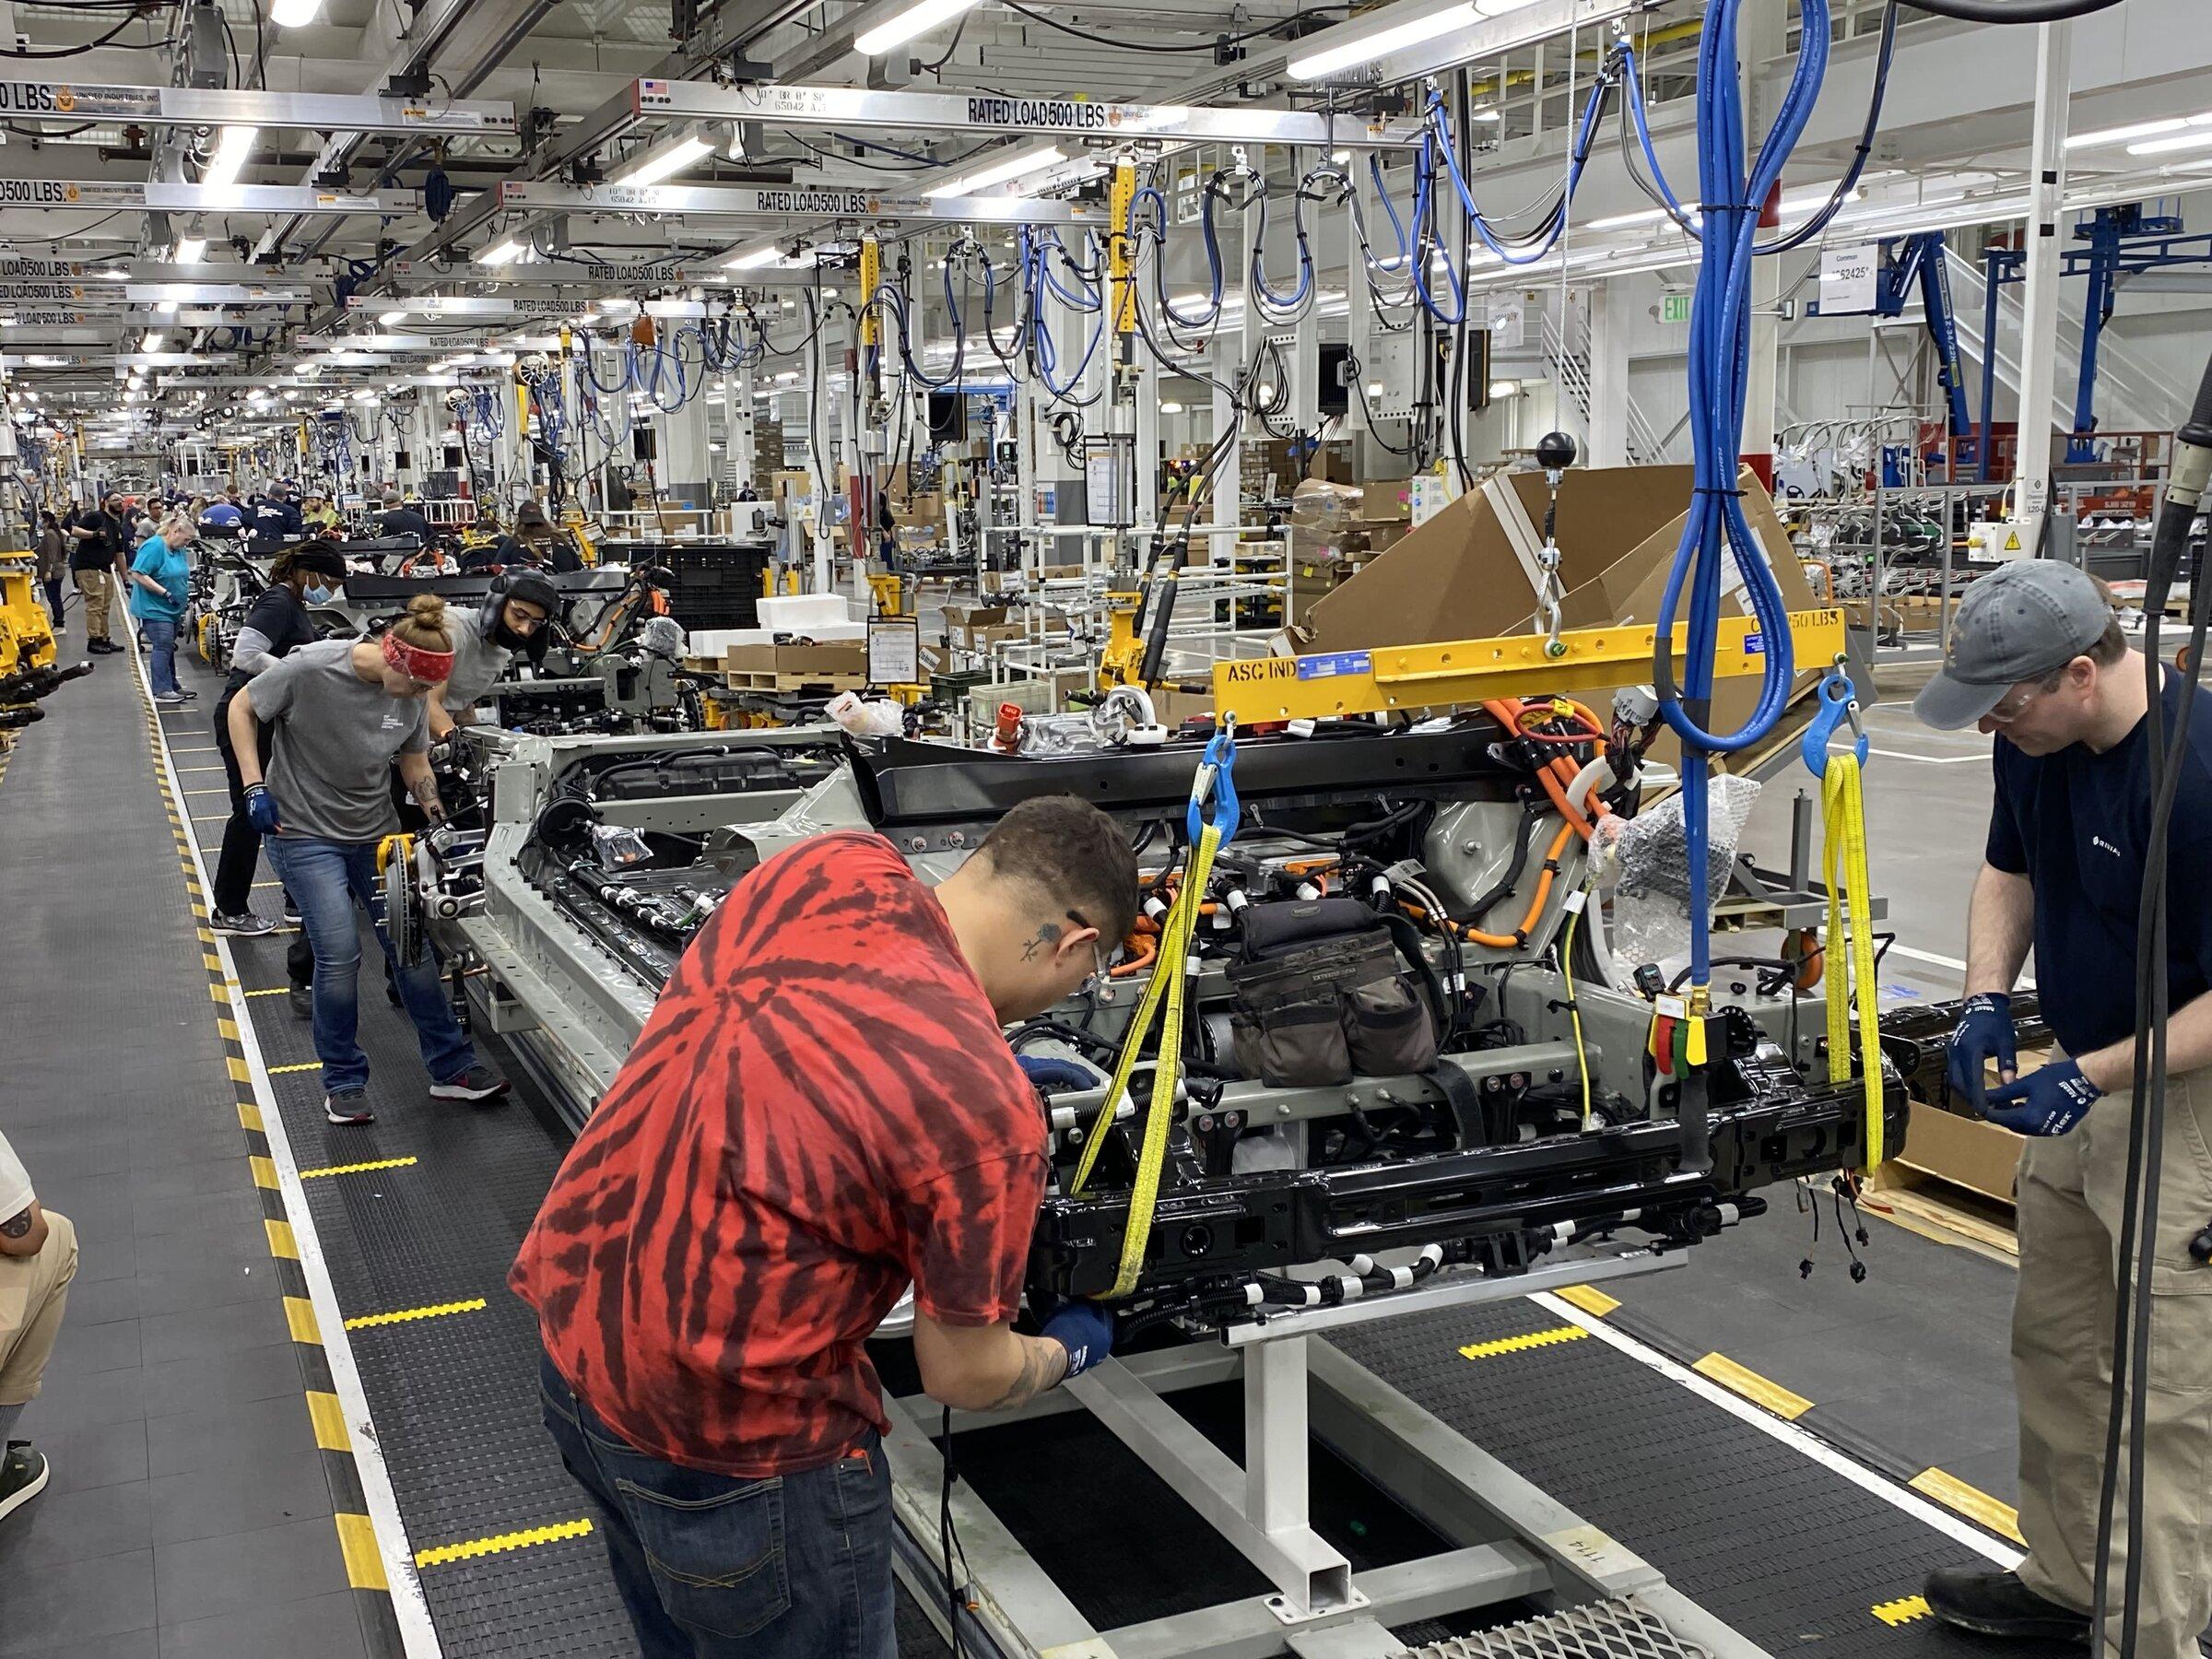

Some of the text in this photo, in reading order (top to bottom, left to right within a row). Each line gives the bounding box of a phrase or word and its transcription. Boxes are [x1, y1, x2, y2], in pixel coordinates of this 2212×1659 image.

[14, 83, 57, 112] LBS.
[968, 98, 1010, 124] RATED
[1014, 100, 1073, 127] LOAD500
[34, 181, 66, 202] LBS.
[758, 192, 869, 215] RATED LOAD500 LBS.
[2, 261, 45, 276] LOAD500
[589, 265, 614, 280] RATED
[617, 266, 653, 280] LOAD500
[12, 286, 50, 299] LOAD500
[513, 300, 535, 312] RATED
[537, 300, 569, 312] LOAD500
[1665, 296, 1690, 320] EXIT
[1812, 610, 1839, 627] LBS
